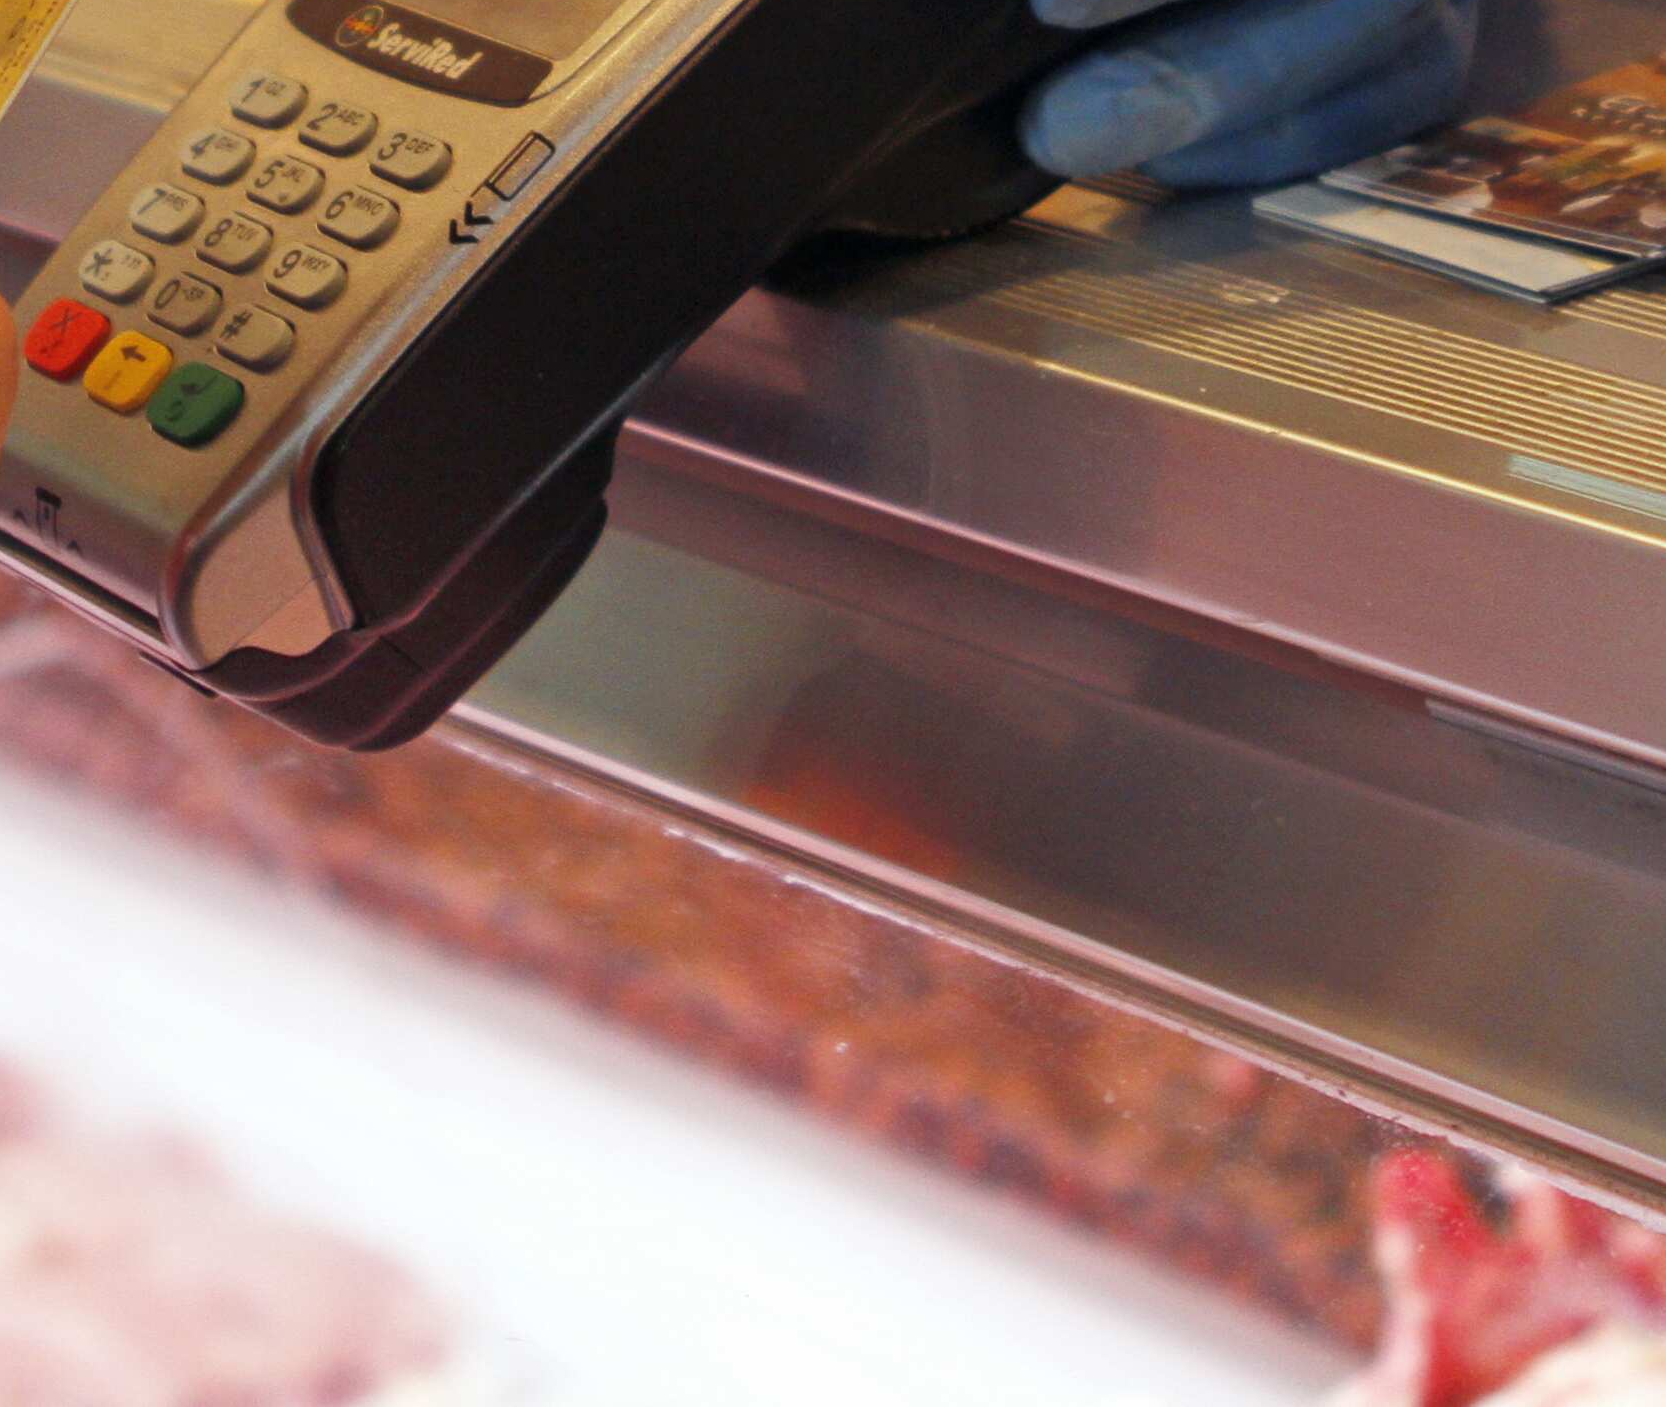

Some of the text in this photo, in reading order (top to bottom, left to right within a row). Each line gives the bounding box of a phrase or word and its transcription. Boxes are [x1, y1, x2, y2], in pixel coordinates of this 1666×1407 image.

[367, 22, 482, 79] ServiRed
[241, 77, 267, 103] 1
[307, 102, 338, 130] 2
[377, 132, 408, 161] 3
[254, 159, 286, 189] 5
[137, 187, 168, 215] 7
[325, 190, 355, 220] 6
[204, 218, 234, 247] 8
[273, 249, 303, 278] 9
[154, 279, 181, 309] 0
